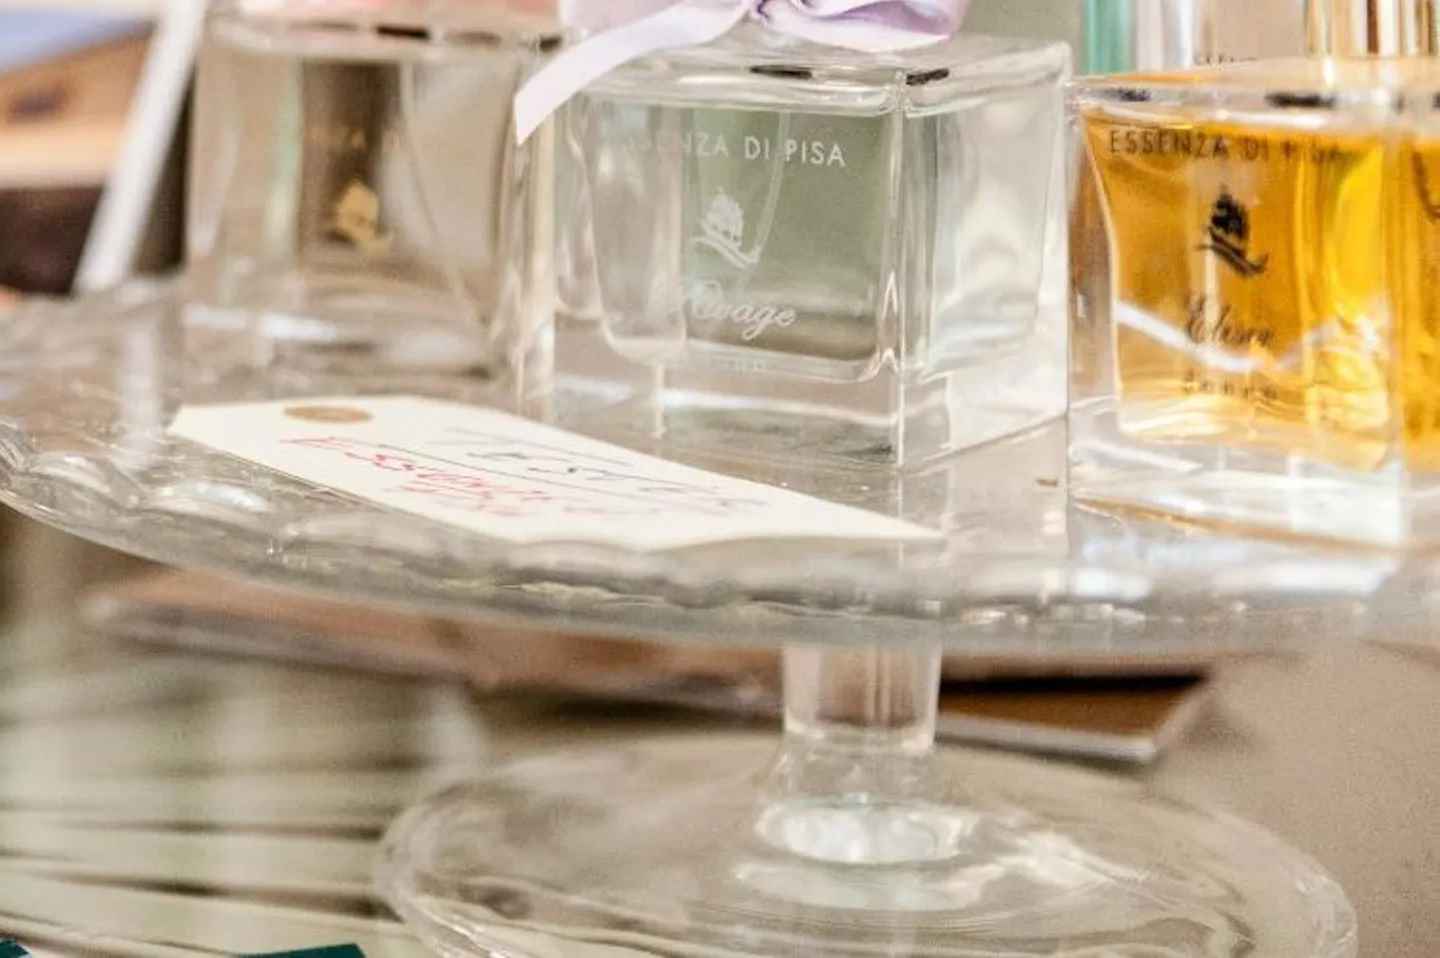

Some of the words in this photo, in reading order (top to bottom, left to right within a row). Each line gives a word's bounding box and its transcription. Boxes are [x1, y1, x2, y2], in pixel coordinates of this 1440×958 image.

[744, 135, 770, 162] DI
[785, 138, 847, 168] PISA
[1109, 129, 1230, 158] ESSENZA
[1243, 136, 1269, 161] DI
